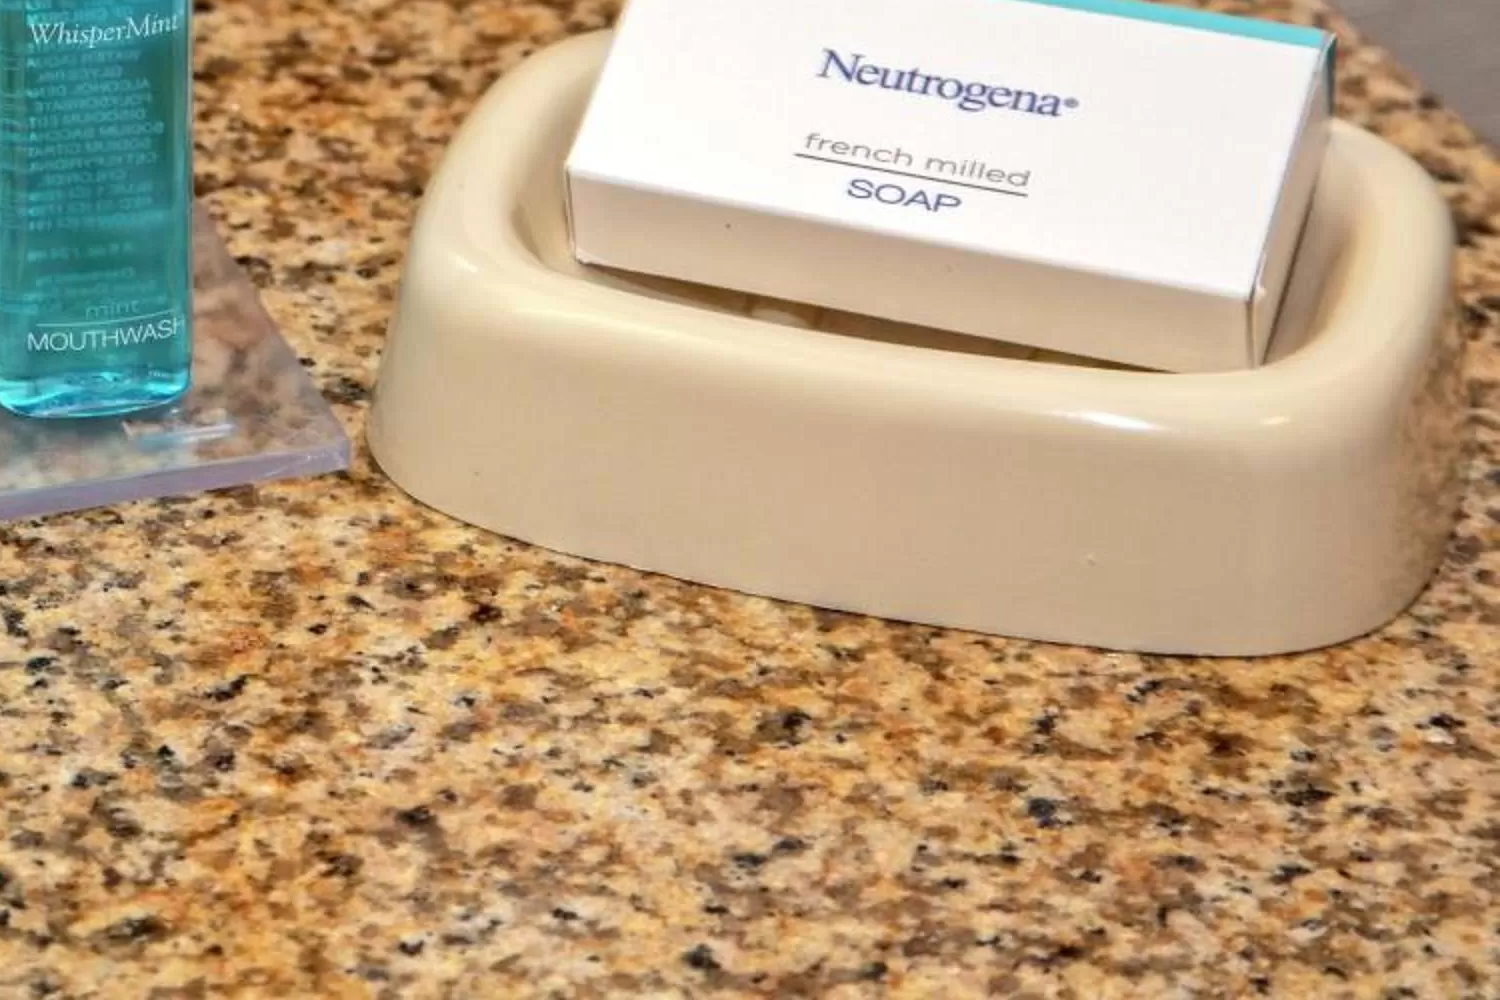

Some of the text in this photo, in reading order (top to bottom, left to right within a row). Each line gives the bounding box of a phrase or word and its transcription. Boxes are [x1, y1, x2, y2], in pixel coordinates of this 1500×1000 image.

[805, 132, 1032, 187] french milled
[847, 178, 963, 213] SOAP
